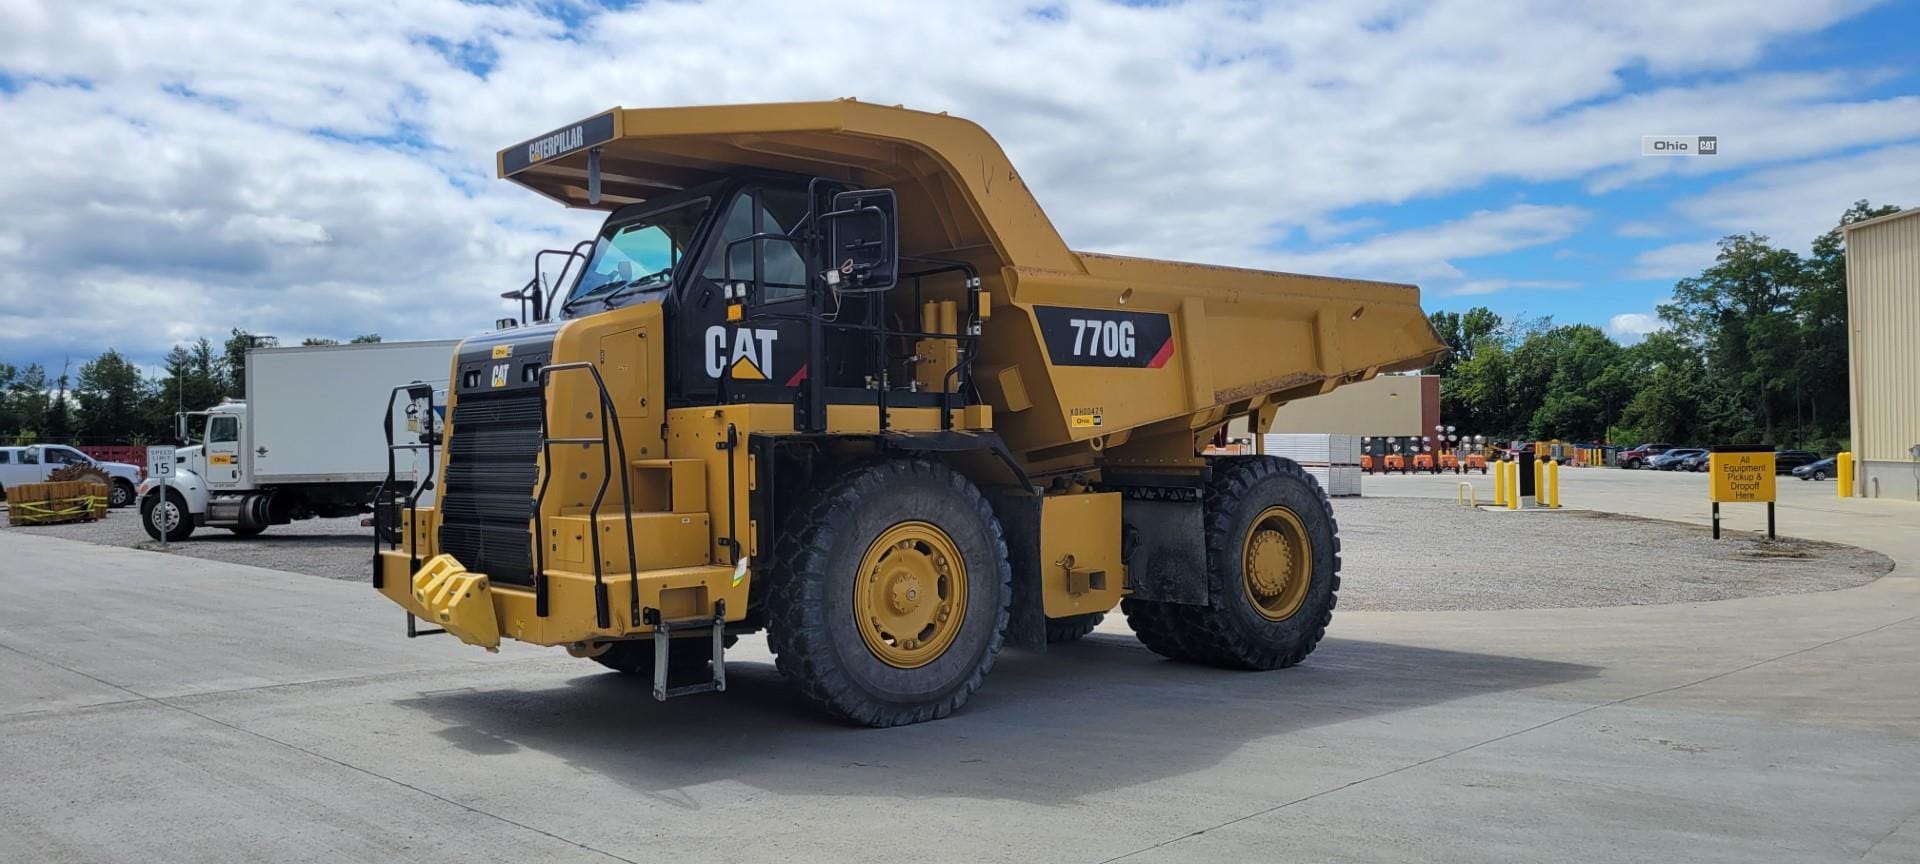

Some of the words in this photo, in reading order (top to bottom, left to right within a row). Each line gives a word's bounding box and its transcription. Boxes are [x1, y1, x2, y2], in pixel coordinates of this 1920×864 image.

[528, 125, 584, 163] CATERPILLAR
[1070, 319, 1136, 358] 770G
[705, 325, 778, 380] CAT
[491, 363, 510, 388] CAT
[1740, 456, 1750, 464] All
[154, 462, 170, 475] 15
[1723, 464, 1767, 473] Equipment
[1727, 473, 1754, 483] Pickup
[1756, 473, 1762, 481] &
[1730, 481, 1760, 491] Dropoff
[1735, 491, 1755, 500] Here
